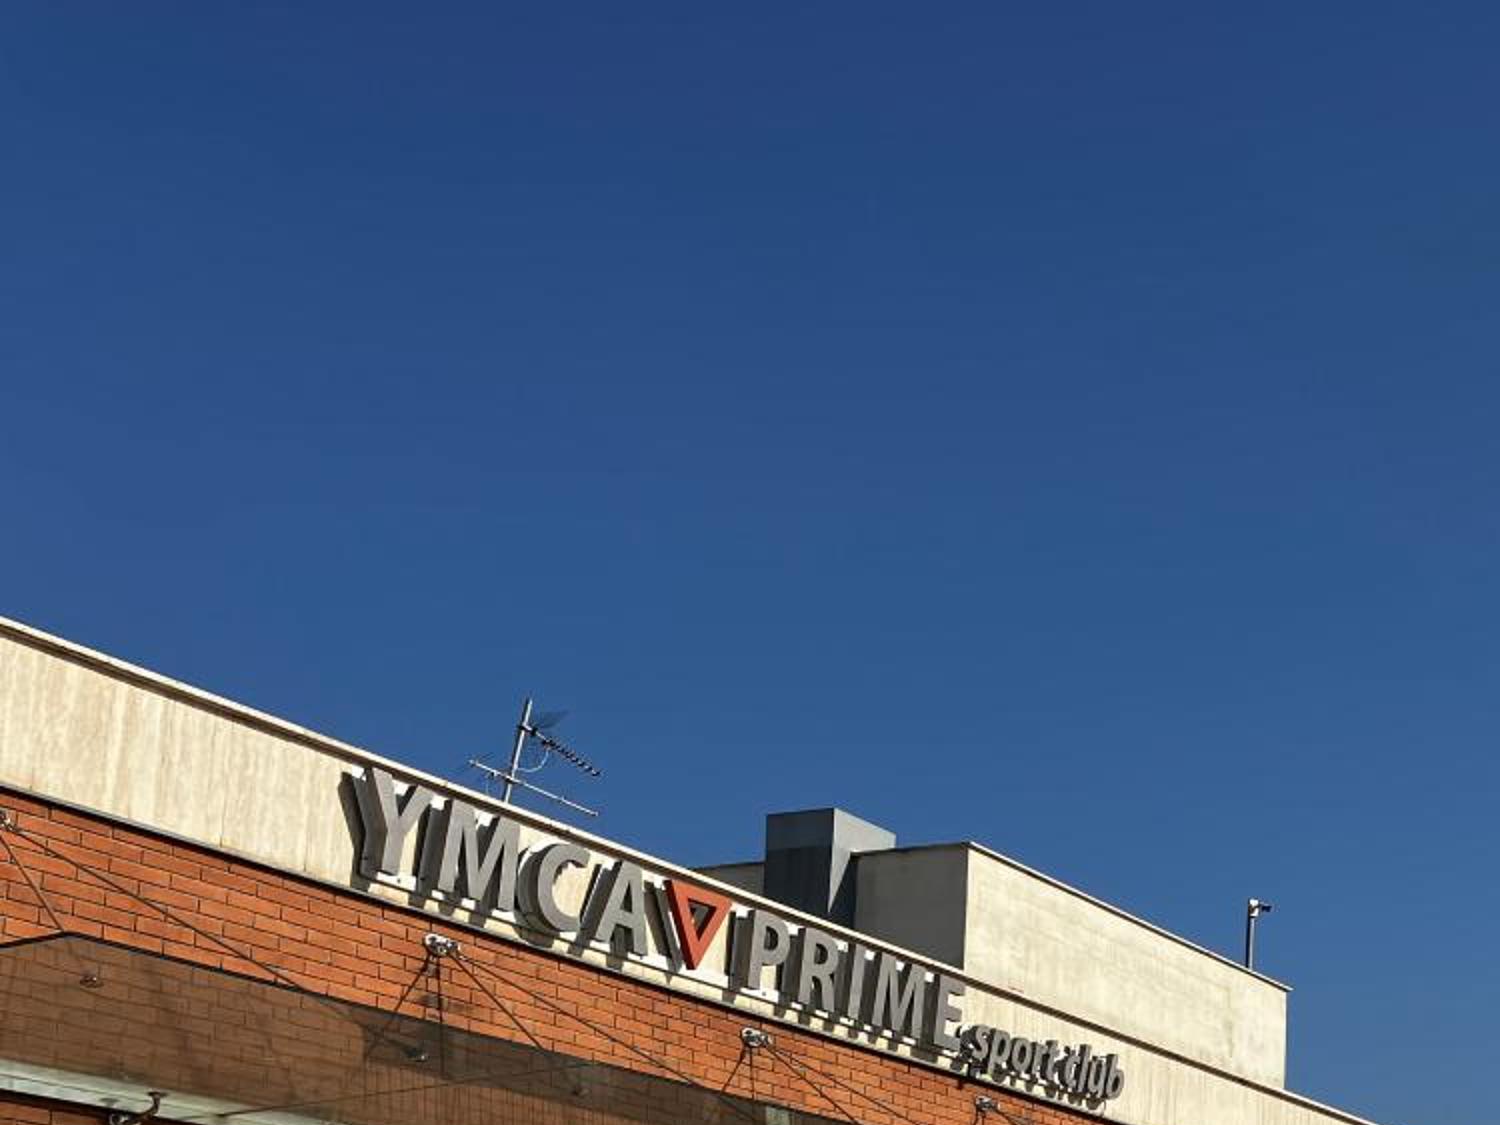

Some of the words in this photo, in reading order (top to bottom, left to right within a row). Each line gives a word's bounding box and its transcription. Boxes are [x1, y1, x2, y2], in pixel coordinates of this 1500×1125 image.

[356, 764, 650, 956] YMCA
[732, 907, 968, 1052] PRIME
[968, 1024, 1060, 1083] sport
[1062, 1043, 1125, 1101] club
